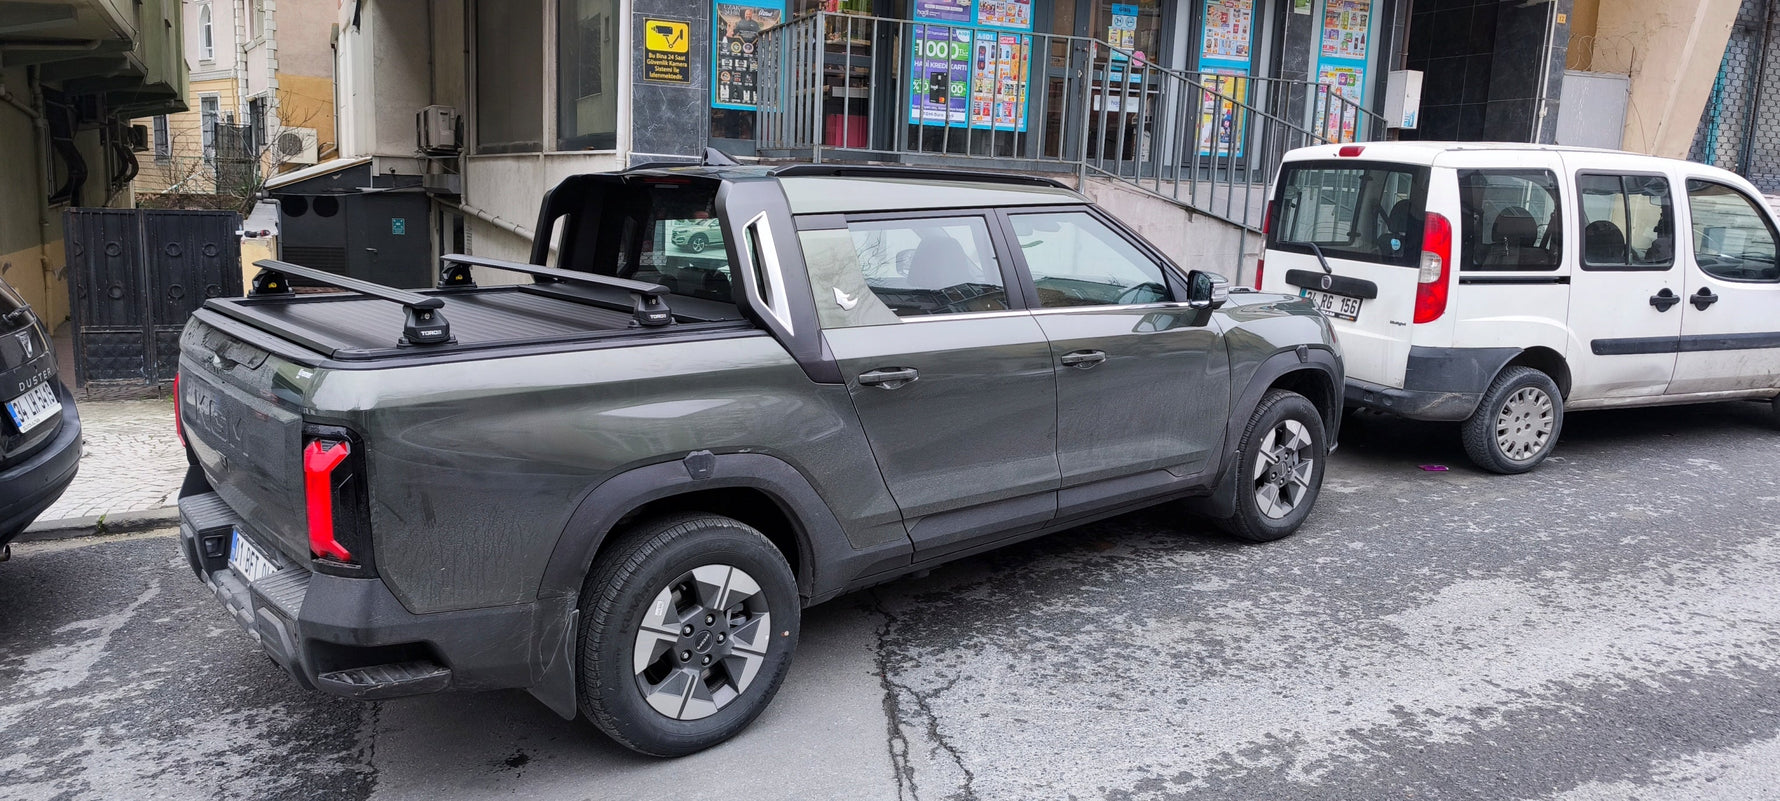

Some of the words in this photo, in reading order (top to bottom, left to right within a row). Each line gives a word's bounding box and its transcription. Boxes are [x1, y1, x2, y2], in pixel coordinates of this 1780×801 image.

[1320, 293, 1334, 310] RG
[1340, 297, 1358, 315] 156
[18, 367, 54, 392] DUSTER
[13, 400, 30, 423] 34
[24, 392, 41, 416] LH
[234, 537, 244, 566] 01
[244, 546, 260, 580] BFT
